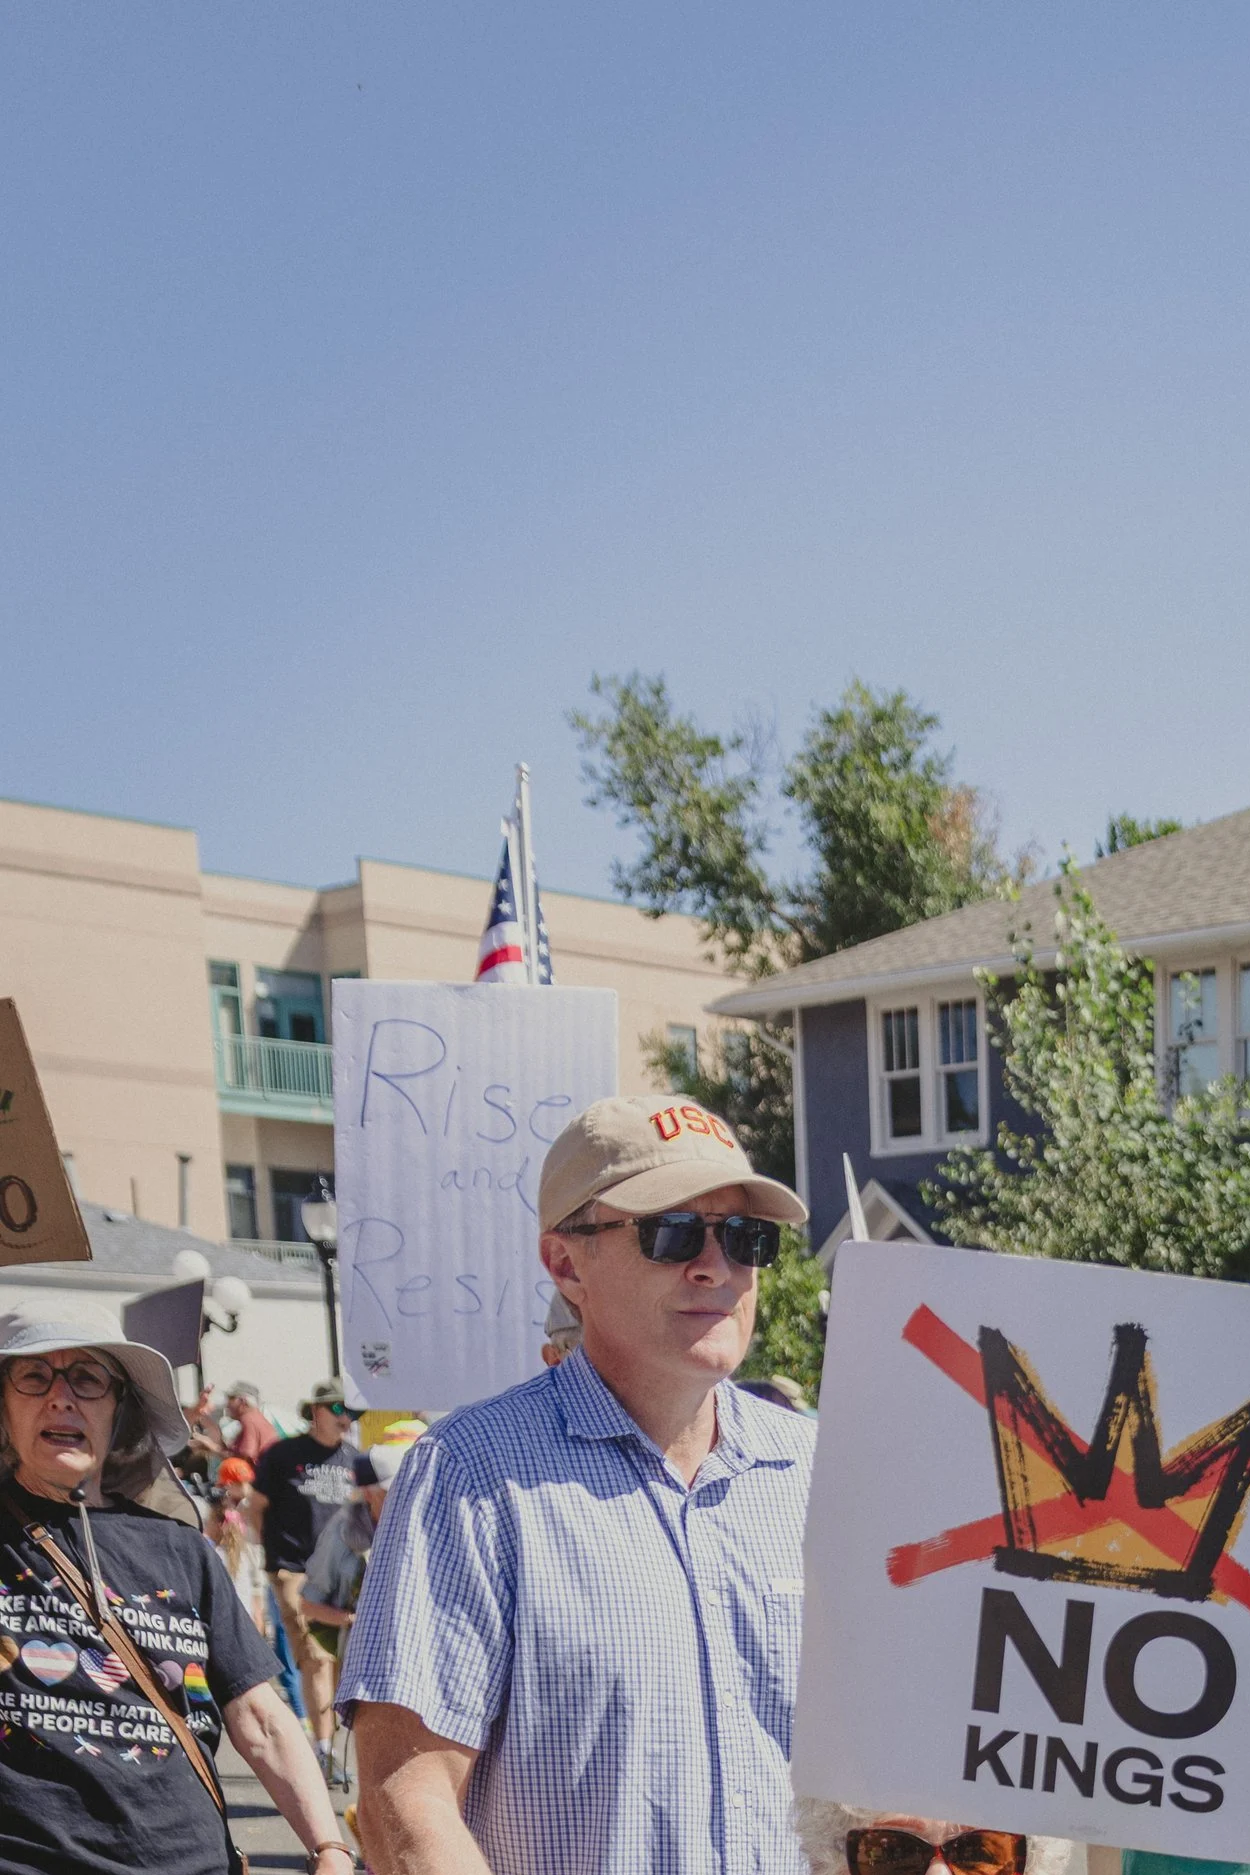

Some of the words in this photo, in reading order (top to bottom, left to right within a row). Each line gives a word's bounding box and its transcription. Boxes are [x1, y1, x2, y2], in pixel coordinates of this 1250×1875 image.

[360, 1018, 572, 1144] Rise
[649, 1106, 735, 1149] USC
[440, 1155, 537, 1217] and
[343, 1217, 556, 1331] Resis
[30, 1594, 87, 1622] LYING
[110, 1605, 167, 1632] RONG
[971, 1586, 1237, 1740] NO
[20, 1693, 106, 1718] HUMANS
[27, 1711, 115, 1738] PEOPLE
[118, 1720, 171, 1744] CARE
[962, 1724, 1226, 1814] KINGS
